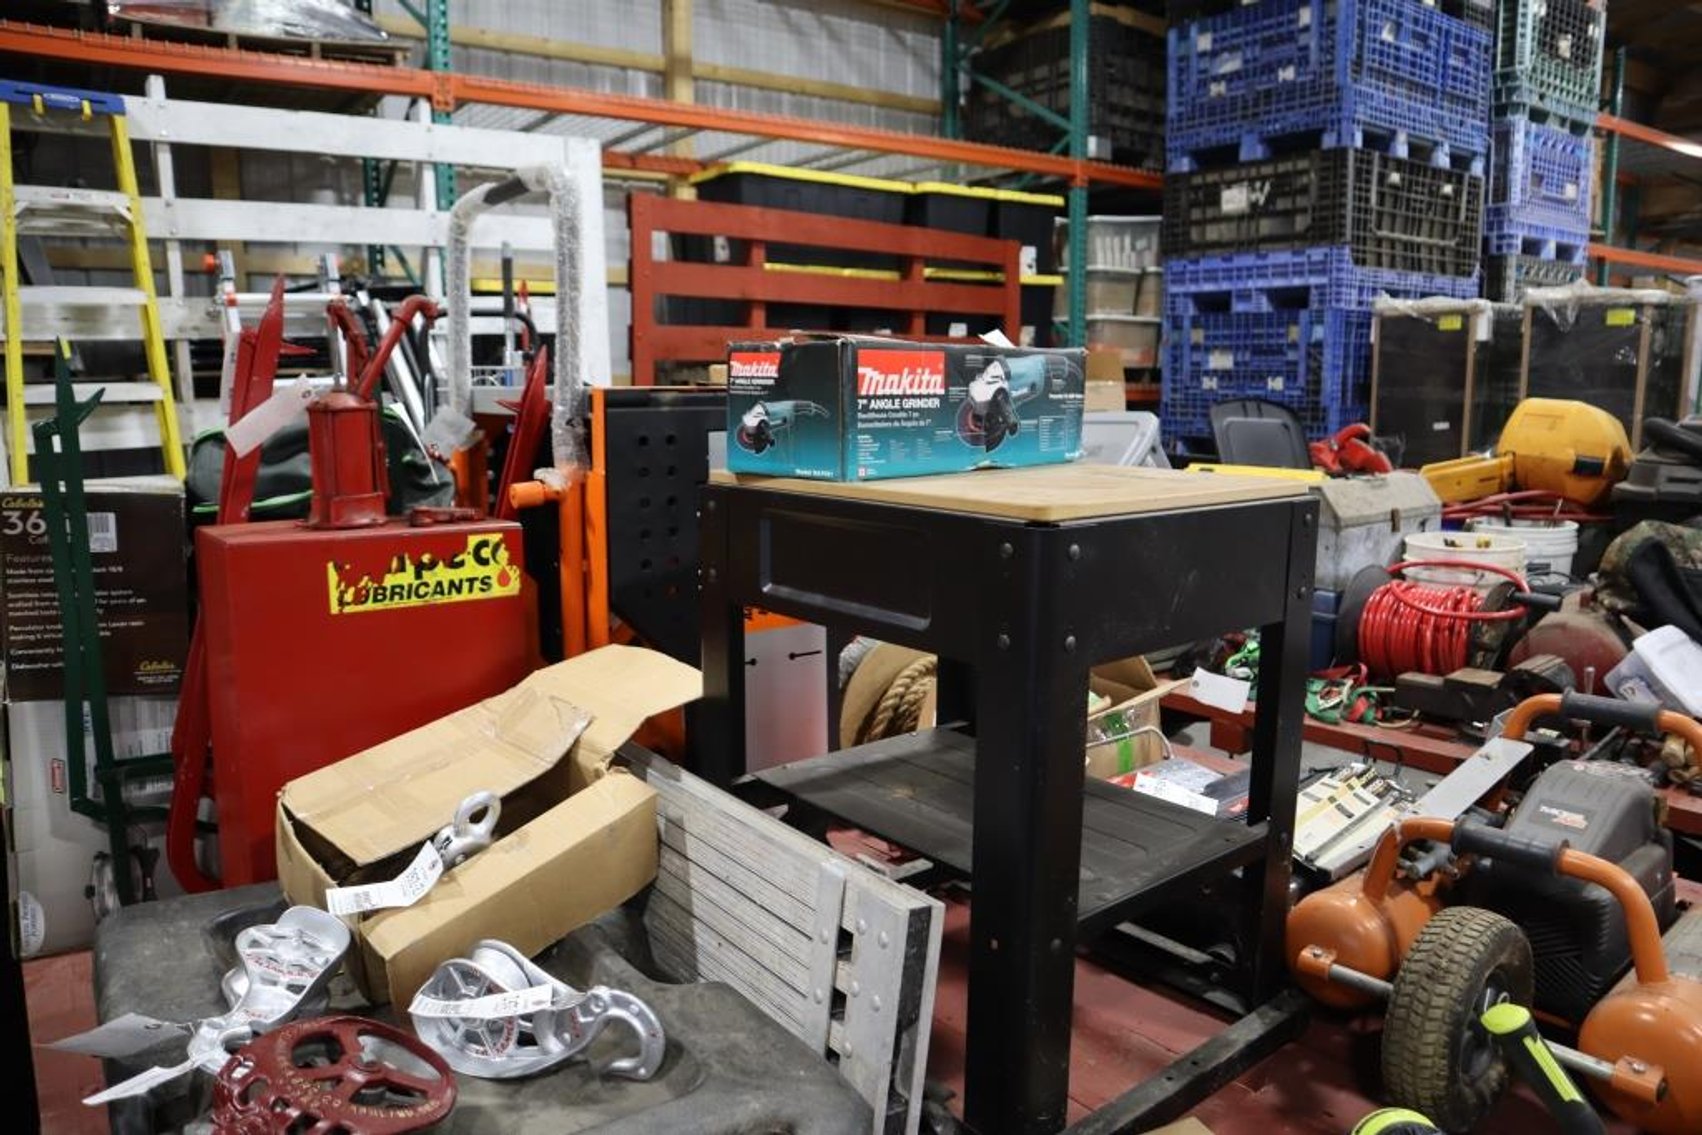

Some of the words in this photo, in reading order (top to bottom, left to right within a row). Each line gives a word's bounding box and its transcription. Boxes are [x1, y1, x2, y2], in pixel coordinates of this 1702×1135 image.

[857, 399, 868, 410] 7"
[869, 398, 901, 410] ANGLE
[902, 397, 941, 409] GRINDER
[2, 510, 47, 535] 36
